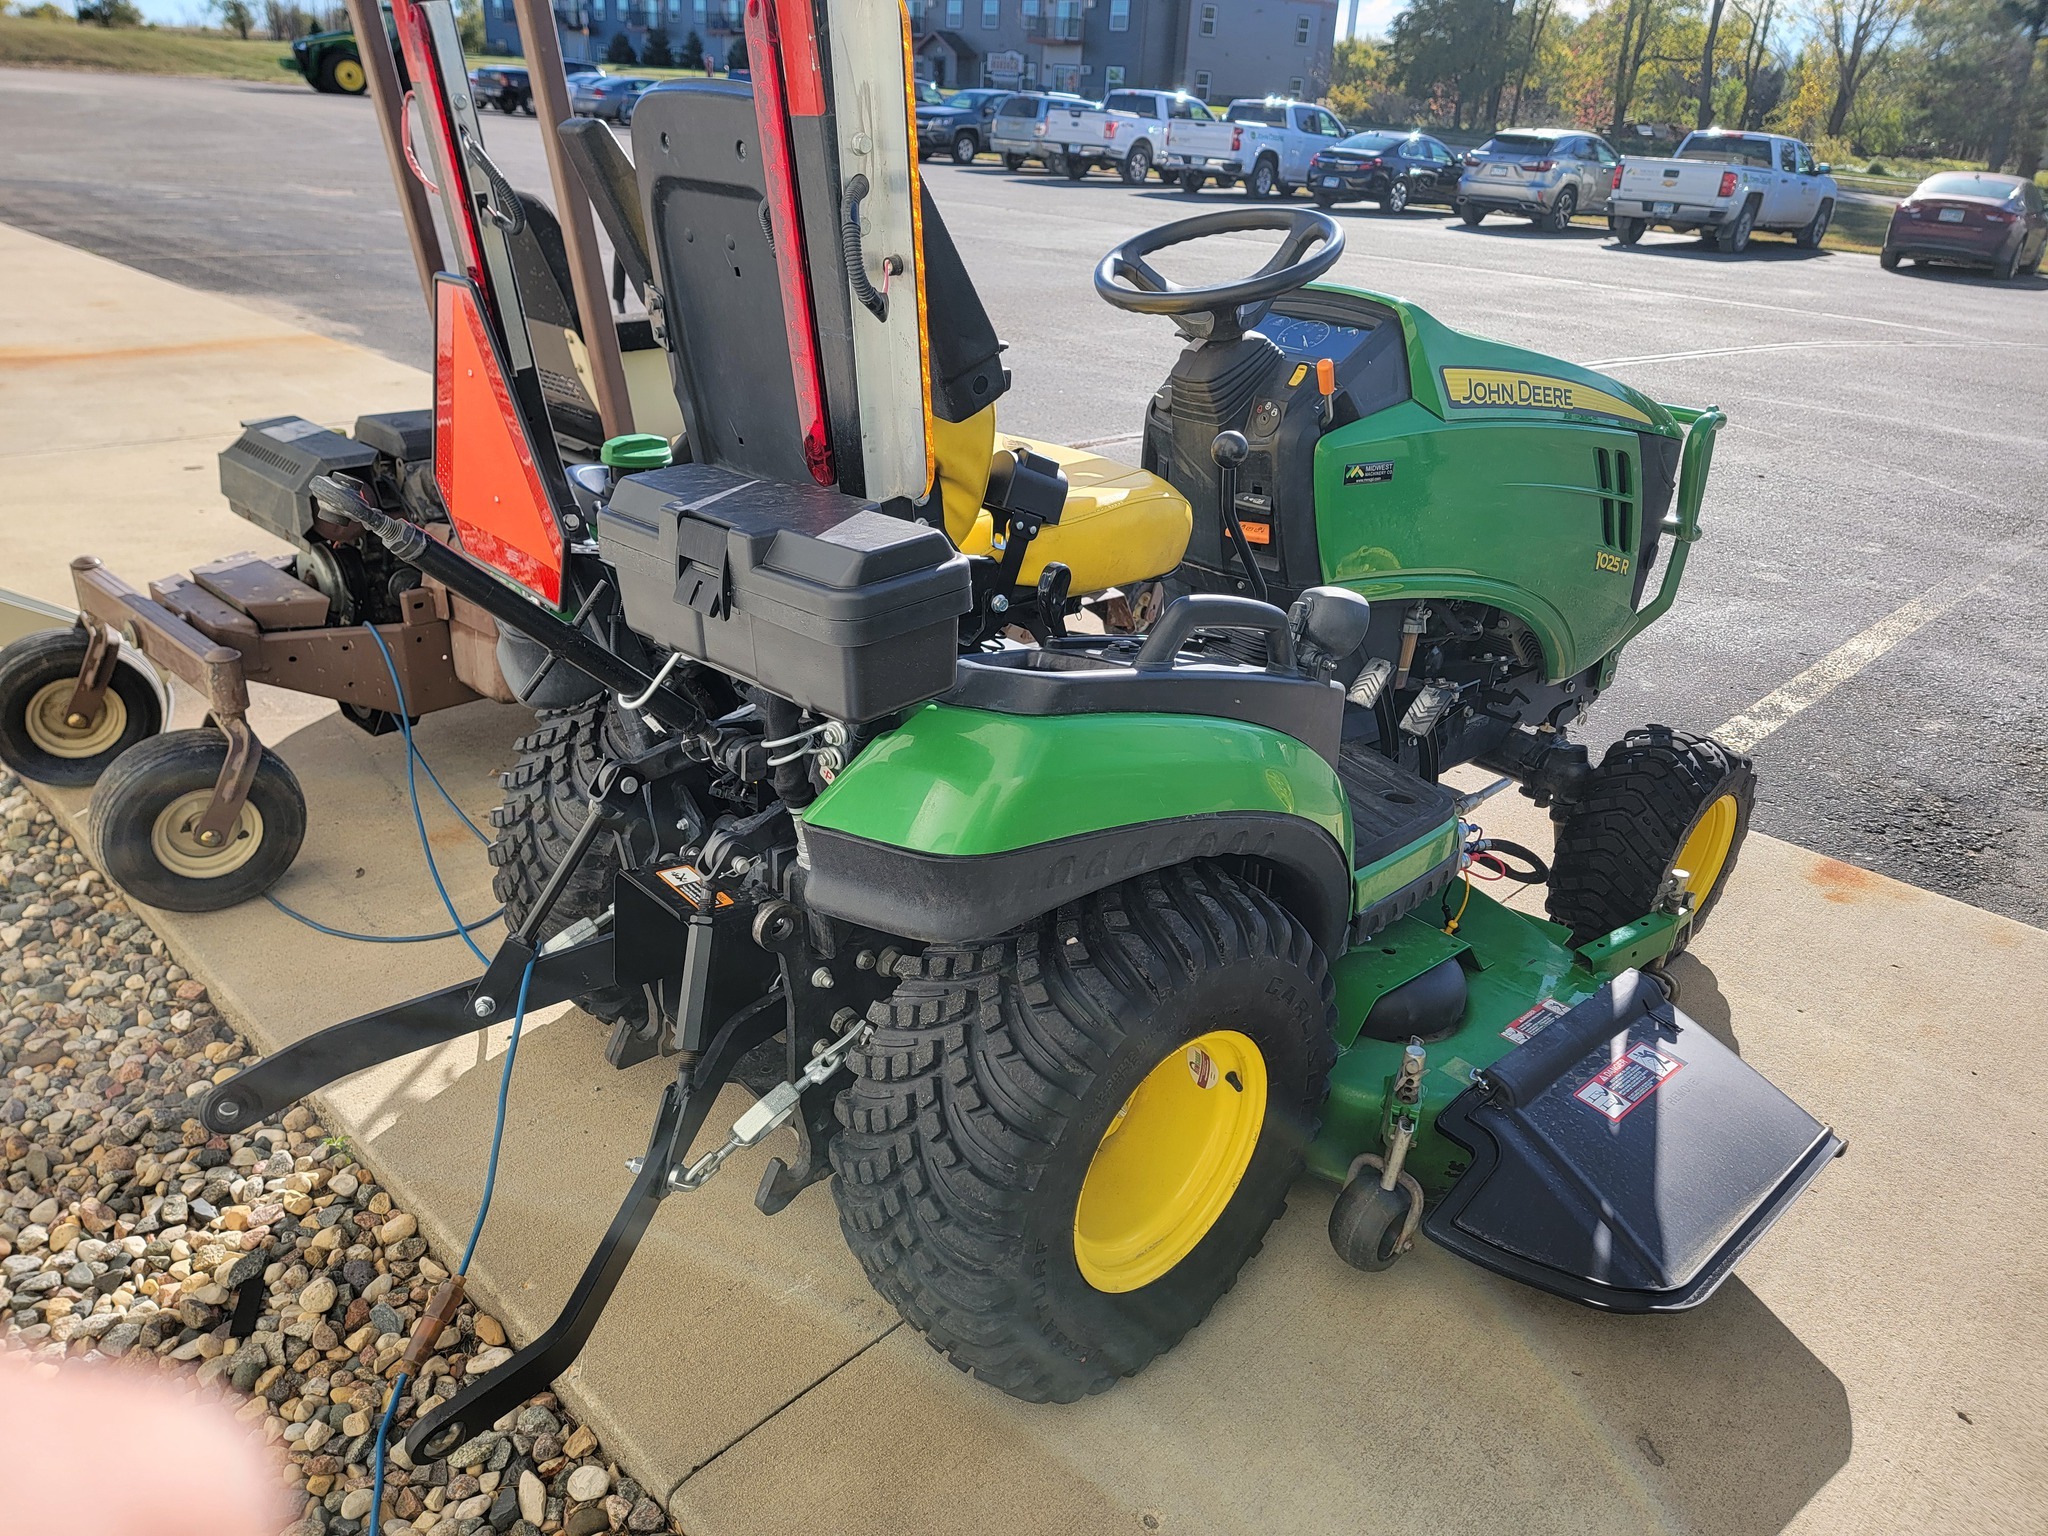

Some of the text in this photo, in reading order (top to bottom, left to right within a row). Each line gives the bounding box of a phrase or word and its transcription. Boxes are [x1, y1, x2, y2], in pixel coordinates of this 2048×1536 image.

[1462, 378, 1573, 406] JOHN DEERE
[1365, 463, 1394, 472] MIDWEST
[1605, 1058, 1629, 1078] DANGER
[1665, 1077, 1698, 1106] REMOVE
